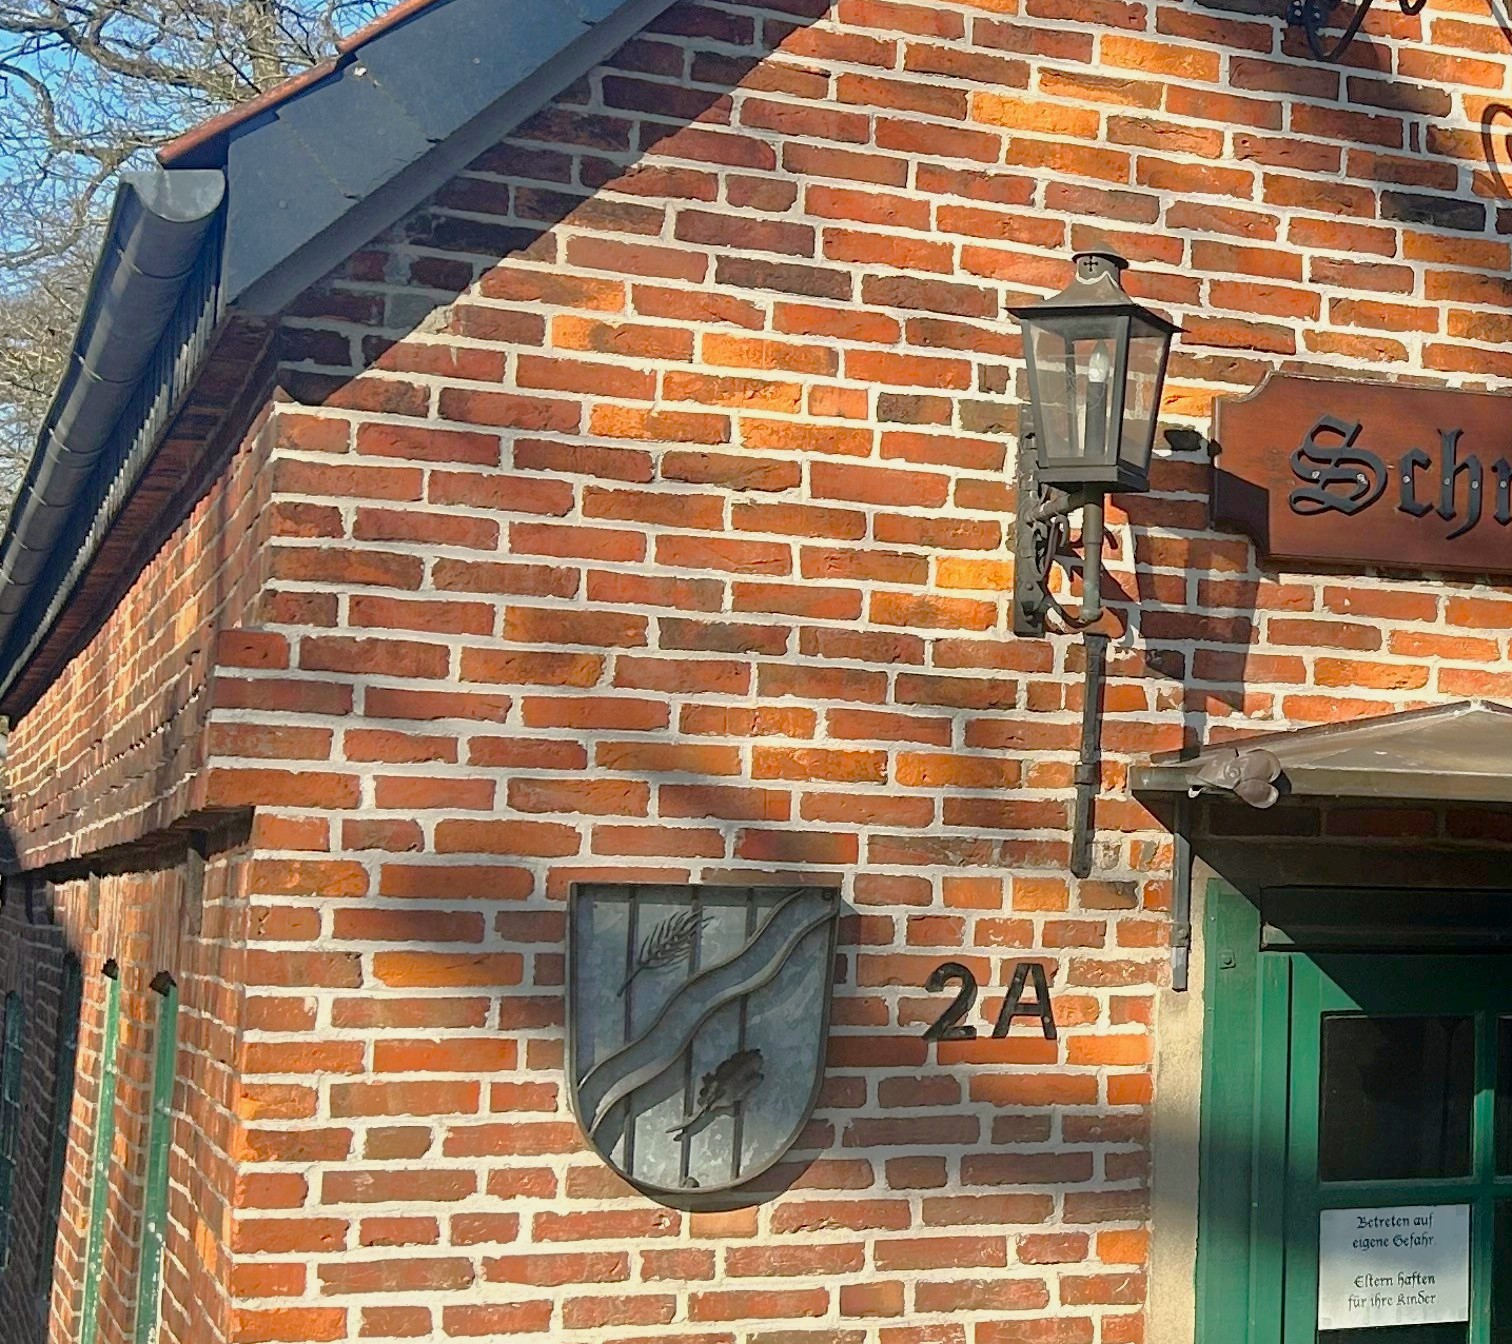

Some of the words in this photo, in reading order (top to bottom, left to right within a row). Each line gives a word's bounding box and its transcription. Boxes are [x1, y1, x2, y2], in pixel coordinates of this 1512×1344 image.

[921, 961, 1058, 1041] 2A
[1356, 1215, 1410, 1229] Betreten
[1413, 1212, 1434, 1228] auf
[1352, 1237, 1390, 1252] eigene
[1353, 1273, 1394, 1288] Eltern
[1397, 1271, 1436, 1289] haften
[1348, 1293, 1368, 1311] für
[1370, 1291, 1393, 1310] ihre
